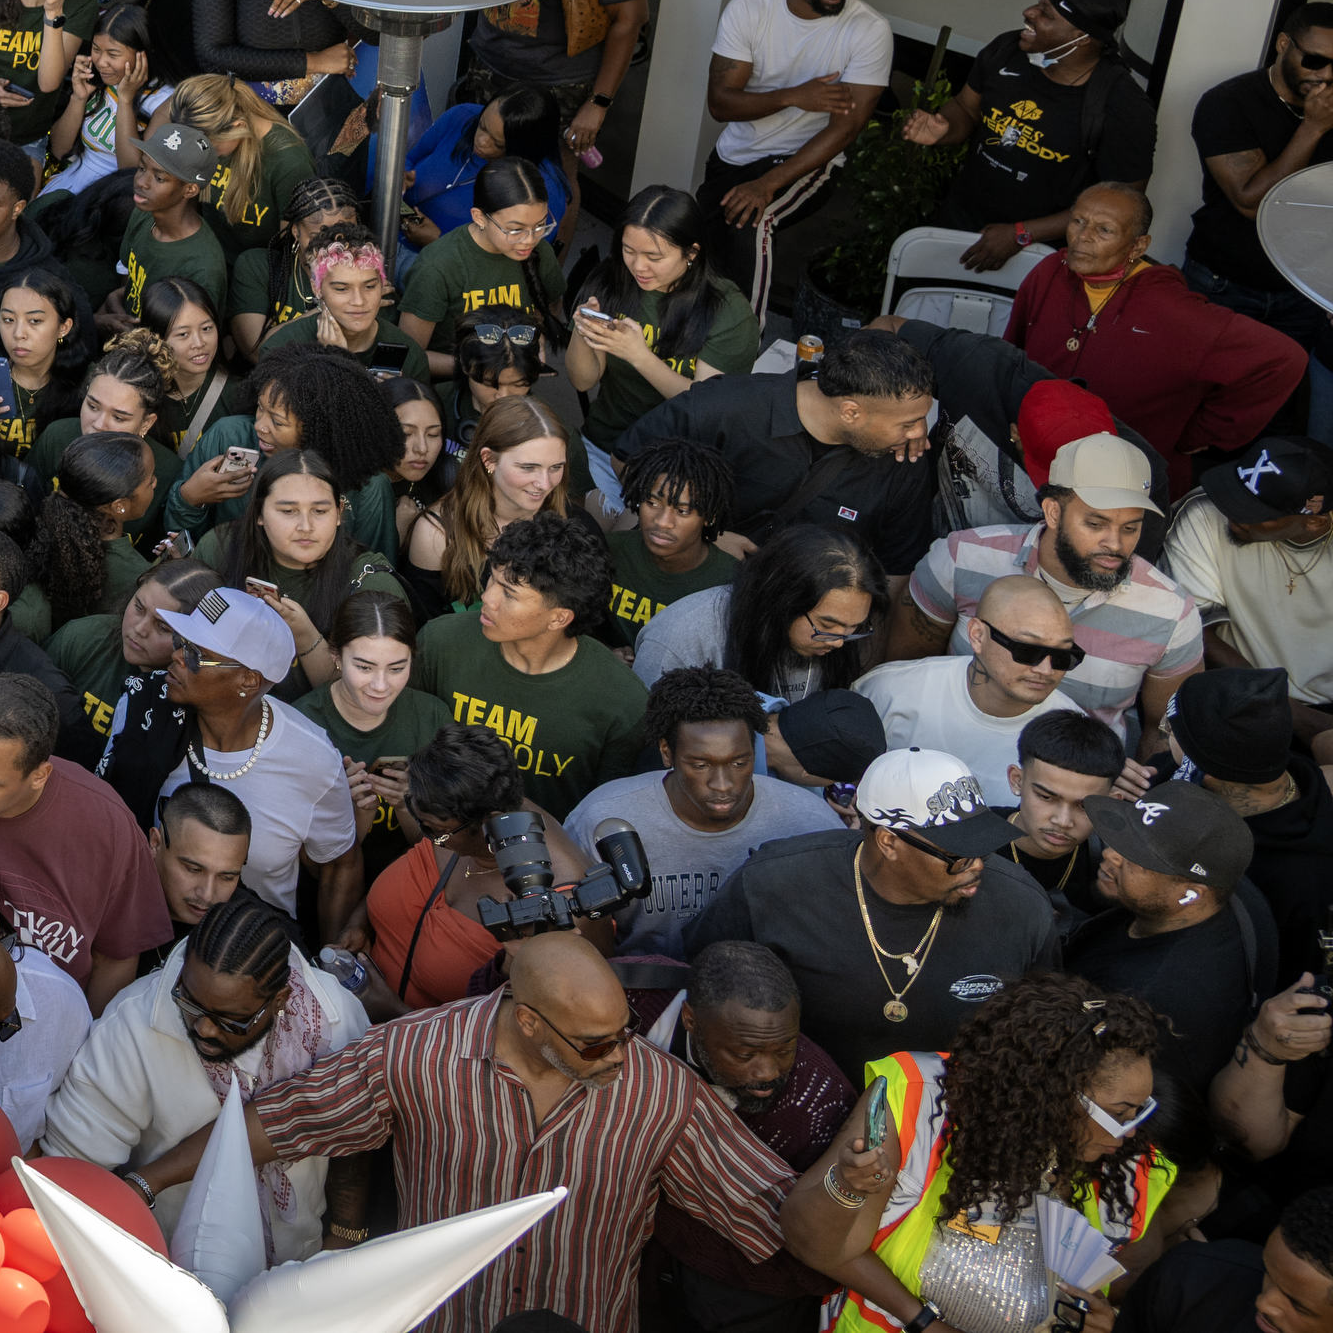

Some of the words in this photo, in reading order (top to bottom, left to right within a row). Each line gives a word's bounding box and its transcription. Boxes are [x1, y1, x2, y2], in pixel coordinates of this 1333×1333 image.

[12, 50, 41, 71] PO
[989, 106, 1045, 143] TAKES
[462, 283, 522, 314] TEAM
[83, 690, 115, 738] TE
[452, 690, 539, 747] TEAM
[641, 872, 706, 916] OUTER
